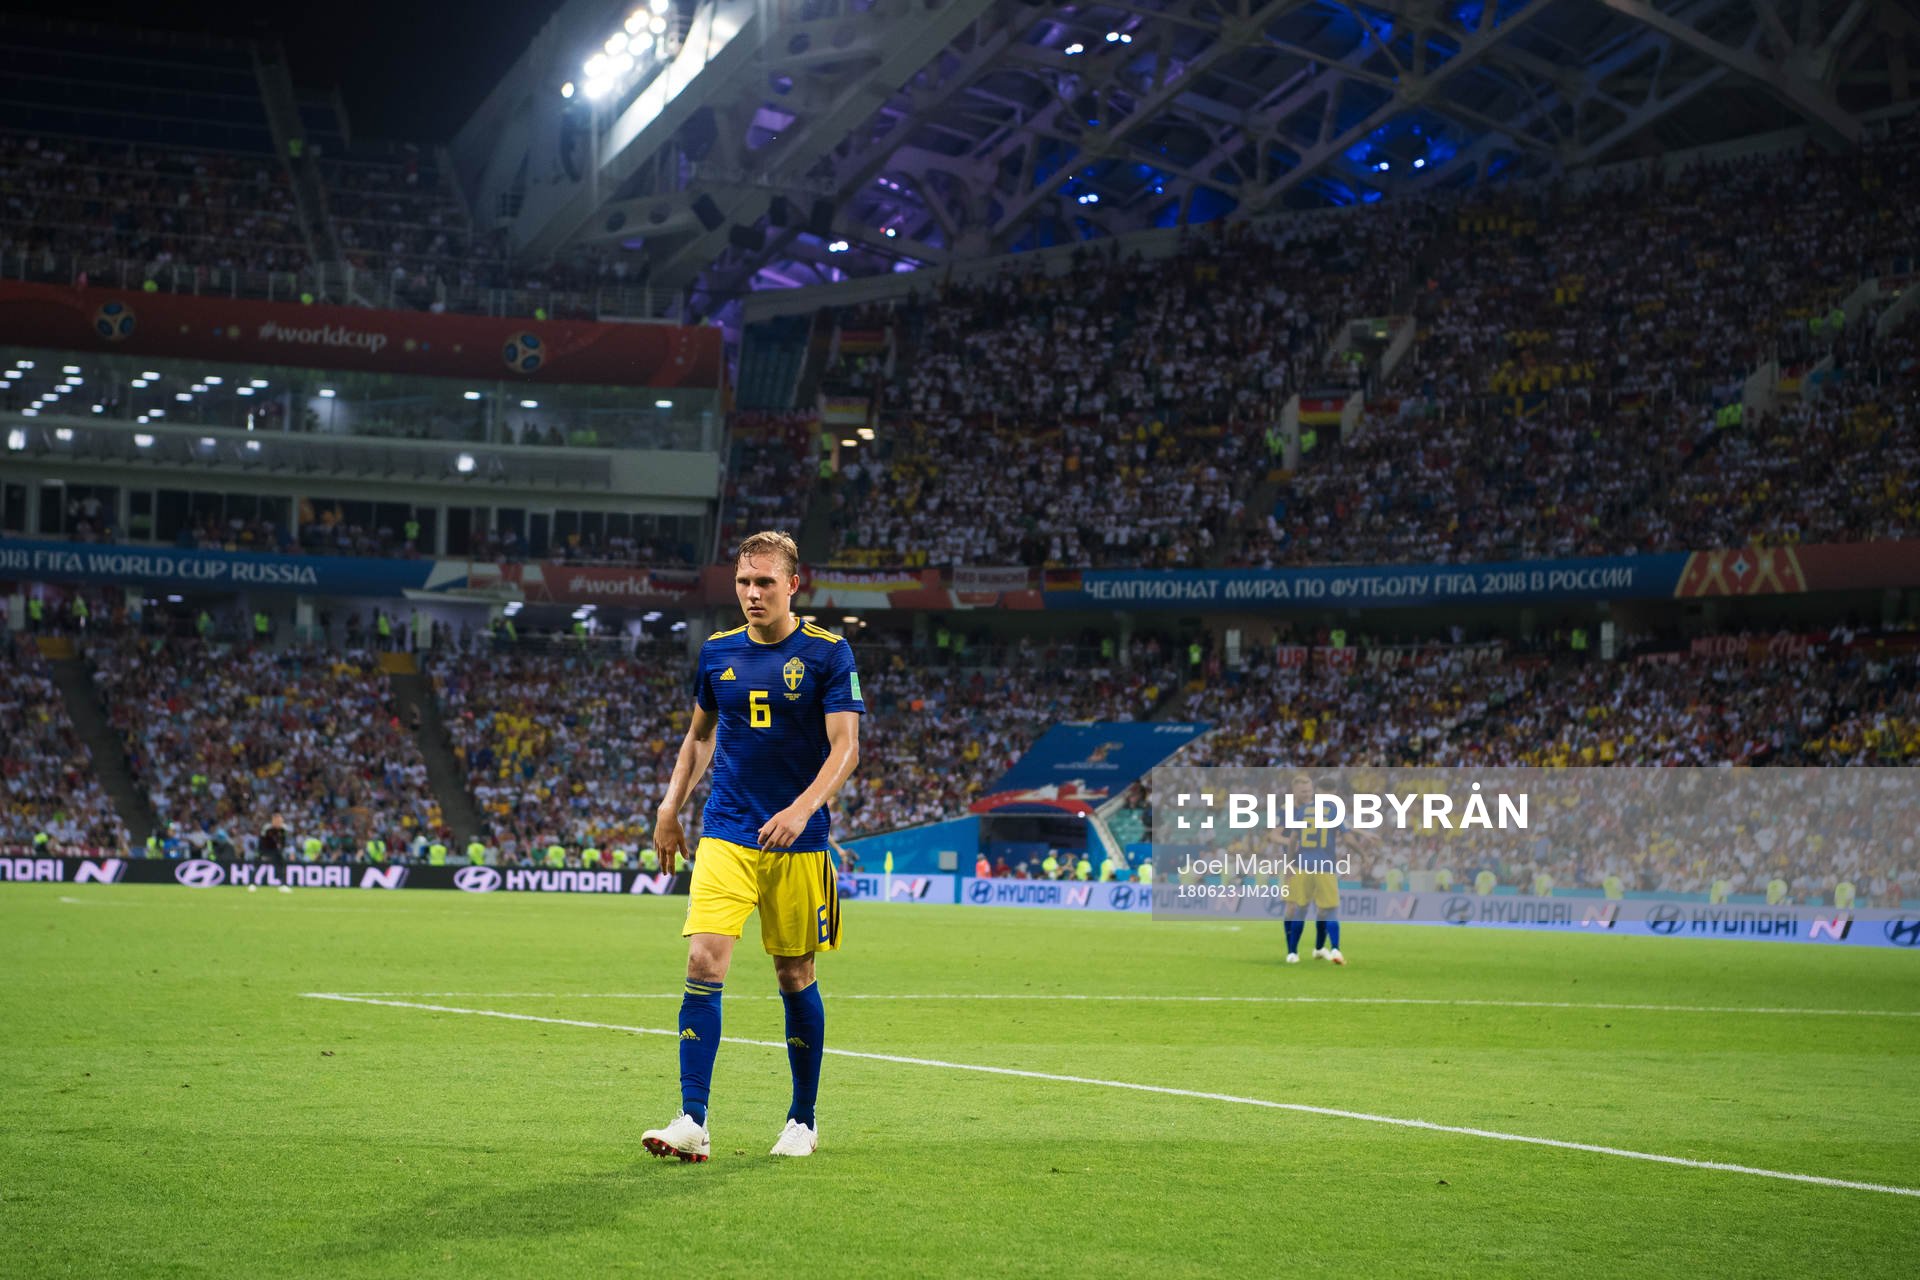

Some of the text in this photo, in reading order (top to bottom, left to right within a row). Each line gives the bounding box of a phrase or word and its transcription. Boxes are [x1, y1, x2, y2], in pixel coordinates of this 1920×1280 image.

[259, 320, 387, 353] #worldcup
[34, 550, 83, 571] FIFA
[89, 553, 174, 576] WORLD
[178, 558, 227, 579] CUP
[232, 561, 318, 584] RUSSIA
[1084, 579, 1220, 600] ЧЕМПИОНАТ
[1225, 579, 1290, 598] МИРА
[1295, 578, 1325, 598] ПО
[1330, 575, 1429, 597] ФУТБОЛУ
[1434, 573, 1477, 594] FIFA
[1481, 572, 1527, 593] 2018
[1550, 567, 1633, 590] РОССИИ
[749, 691, 772, 728] 6
[506, 869, 621, 892] HYUNDAI
[997, 884, 1060, 905] HYUNDAI
[1481, 900, 1571, 926] HYUNDAI
[1692, 908, 1799, 936] HYUNDAI
